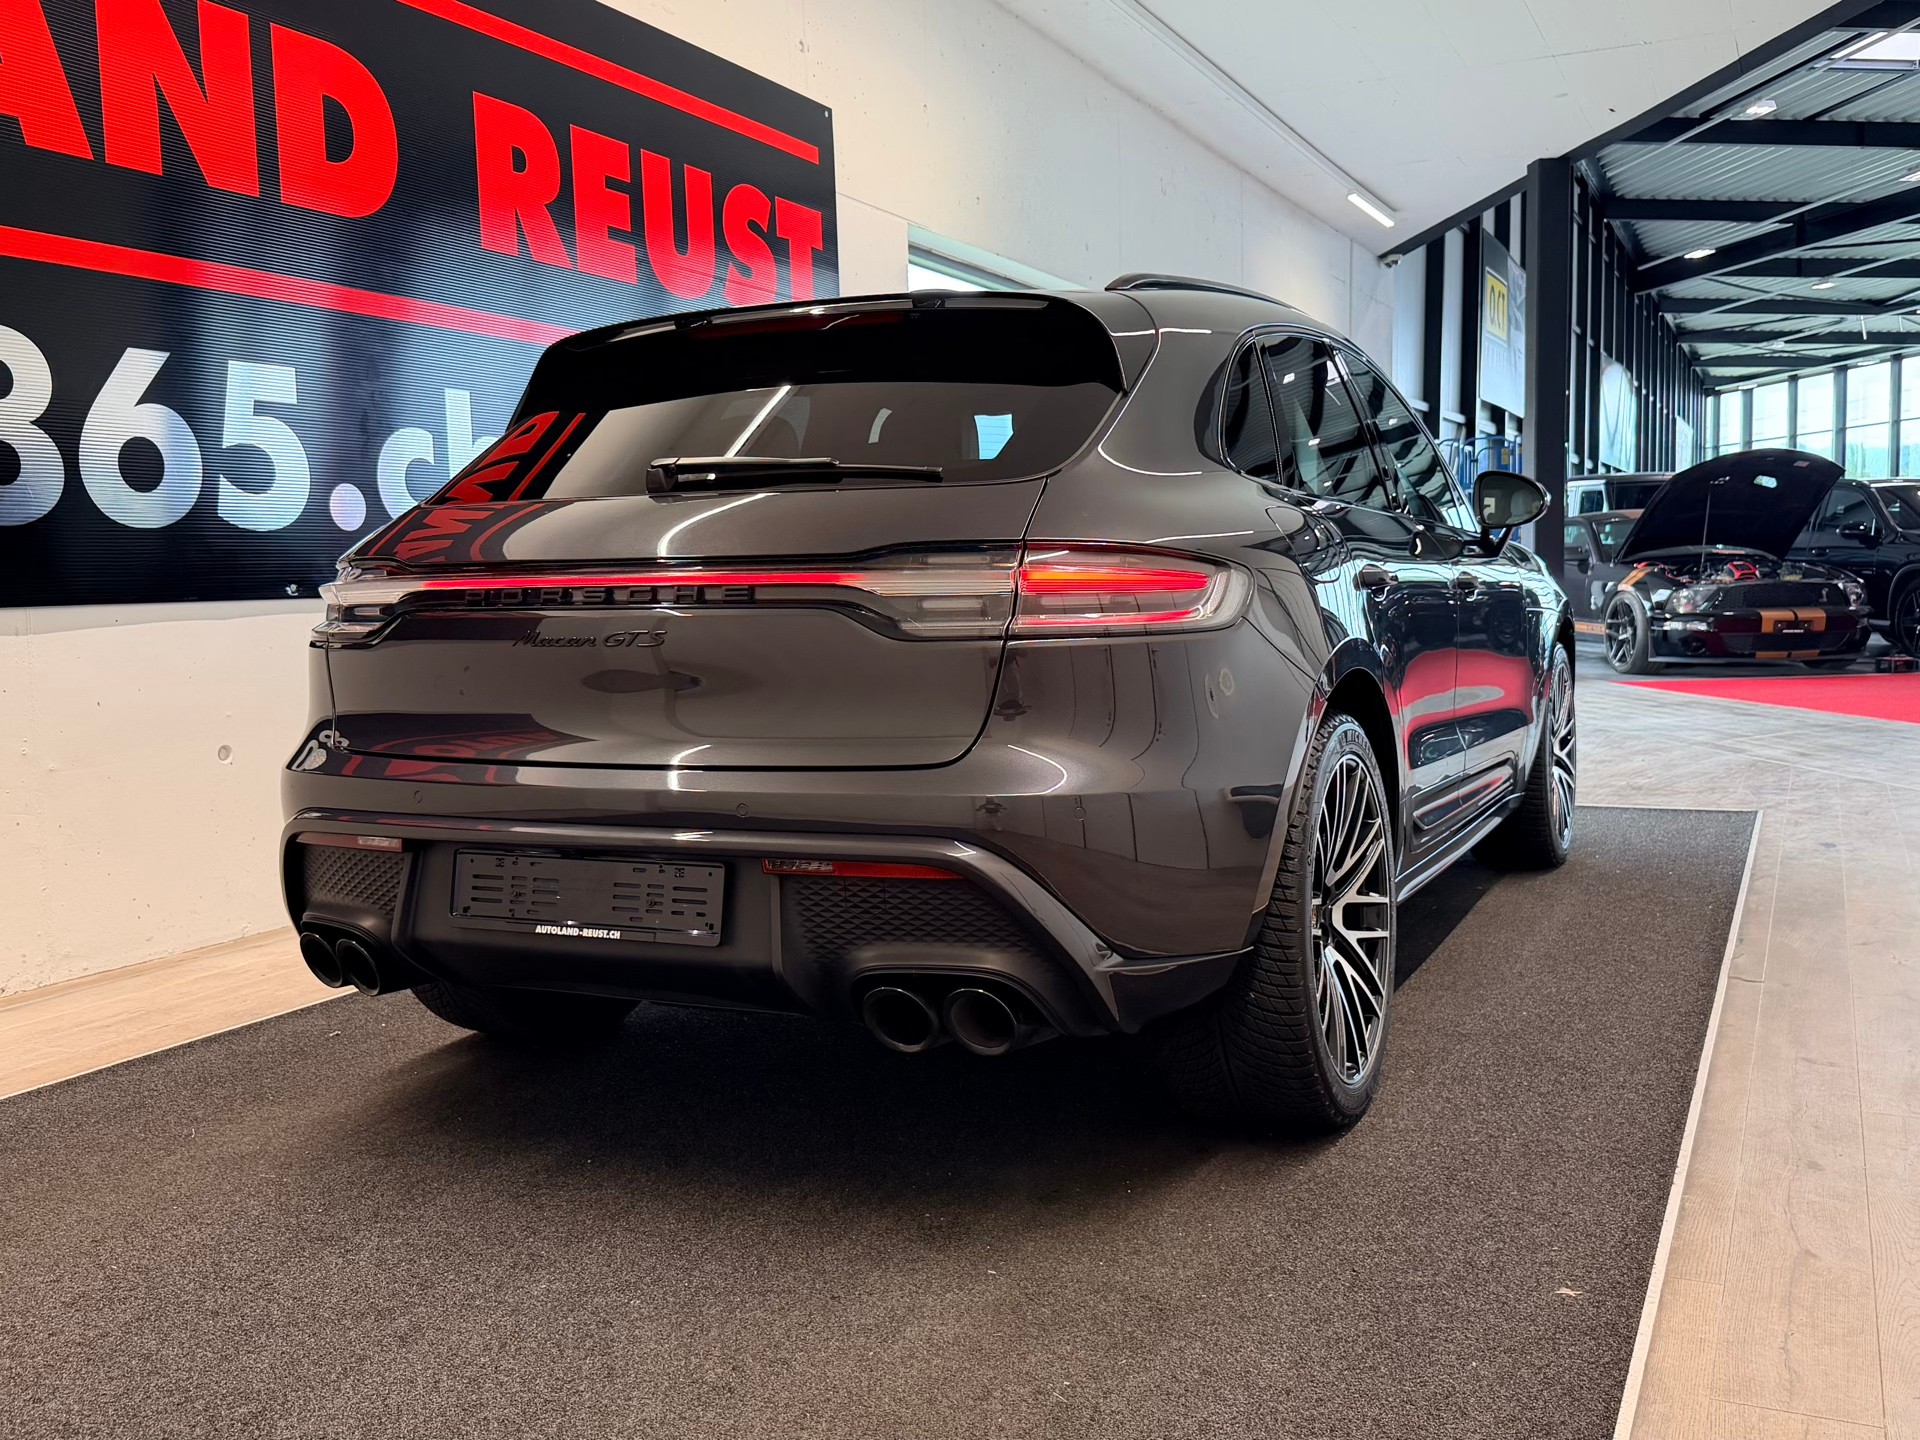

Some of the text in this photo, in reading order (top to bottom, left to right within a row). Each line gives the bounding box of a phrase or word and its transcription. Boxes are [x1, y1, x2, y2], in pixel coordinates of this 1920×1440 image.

[473, 91, 823, 307] REUST
[464, 585, 750, 606] PORSCHE
[512, 630, 668, 647] Macan GTS
[535, 924, 621, 939] AUTOLAND-REUST.CH
